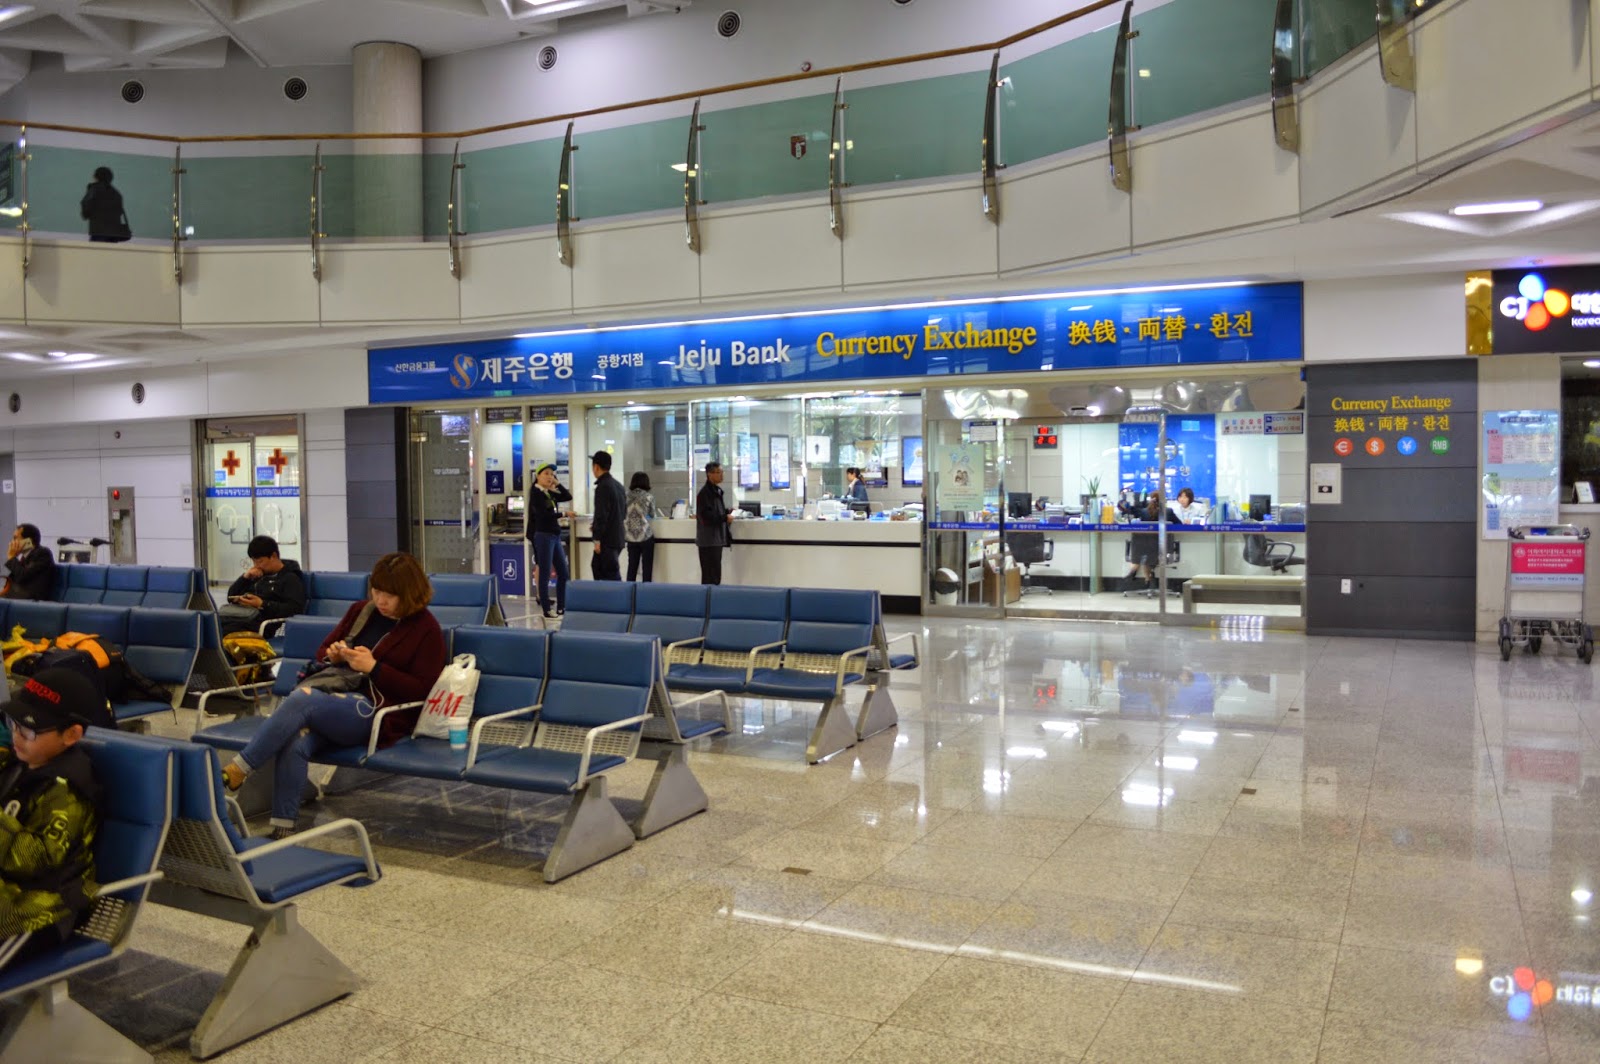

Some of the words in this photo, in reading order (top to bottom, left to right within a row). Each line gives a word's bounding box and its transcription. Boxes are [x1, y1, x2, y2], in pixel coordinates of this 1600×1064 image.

[1500, 296, 1528, 320] CJ
[1209, 311, 1254, 338] 환전
[675, 340, 721, 371] Jeju
[731, 338, 791, 366] Bank
[816, 330, 918, 361] Currency
[923, 323, 1037, 353] Exchange
[481, 352, 574, 383] 제주은행
[597, 352, 644, 369] 공항지점
[1331, 397, 1388, 412] Currency
[1391, 396, 1451, 411] Exchange
[1422, 414, 1449, 431] 환전
[424, 689, 465, 718] H&M
